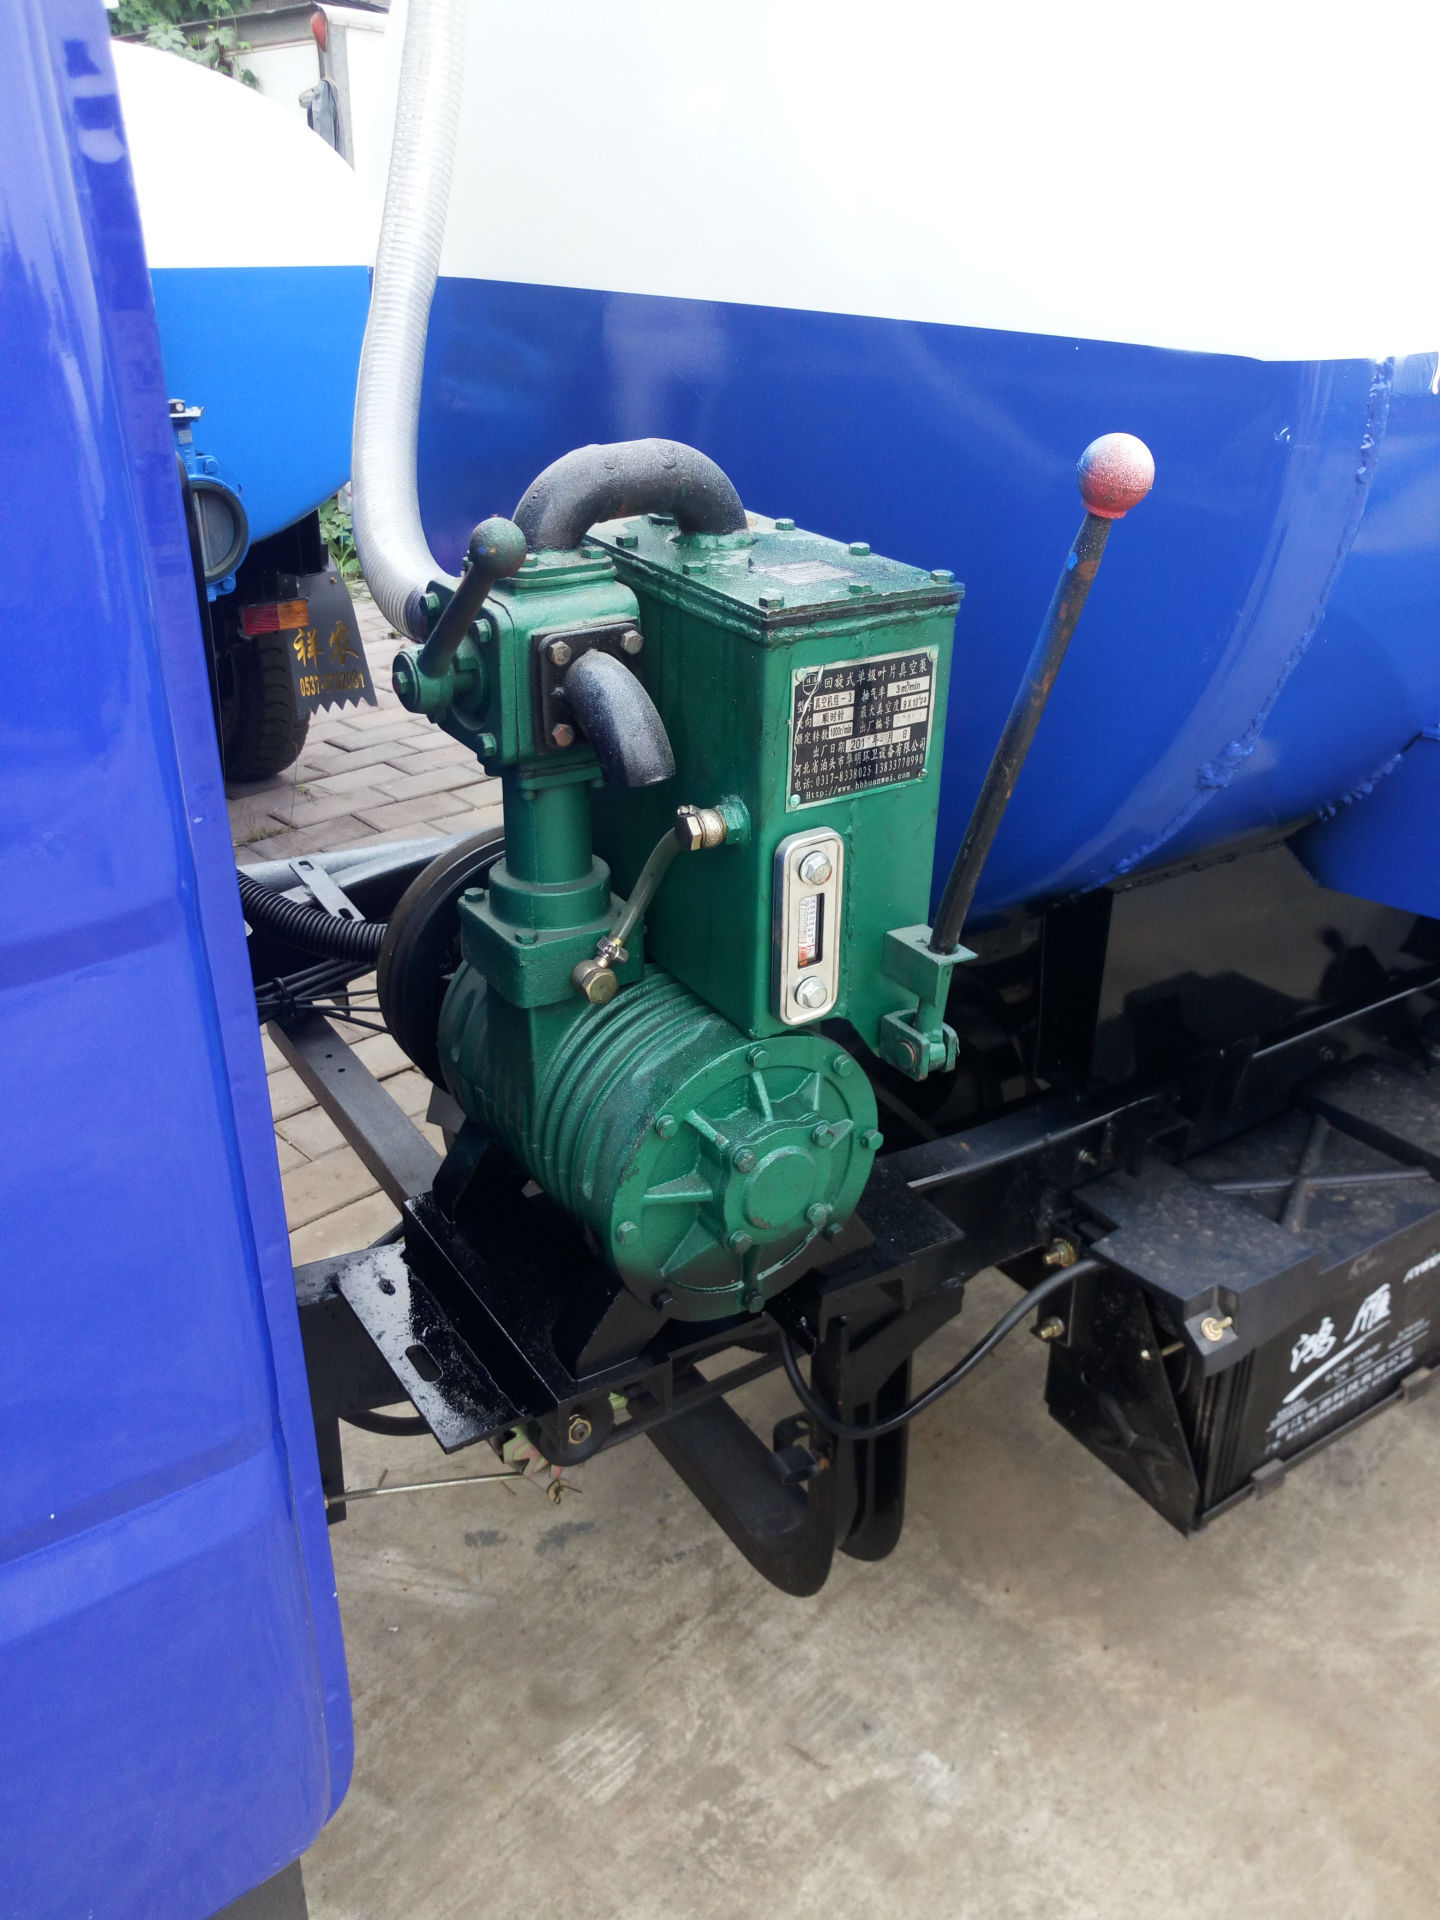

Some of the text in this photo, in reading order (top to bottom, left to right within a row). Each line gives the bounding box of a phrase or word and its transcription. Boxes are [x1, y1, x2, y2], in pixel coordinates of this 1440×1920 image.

[824, 658, 928, 690] 回旋式单级叶片真空泵
[822, 709, 844, 723] 顺时针
[860, 699, 901, 719] 最大真空度
[859, 716, 891, 733] 出厂编号
[813, 740, 846, 757] 出厂日期
